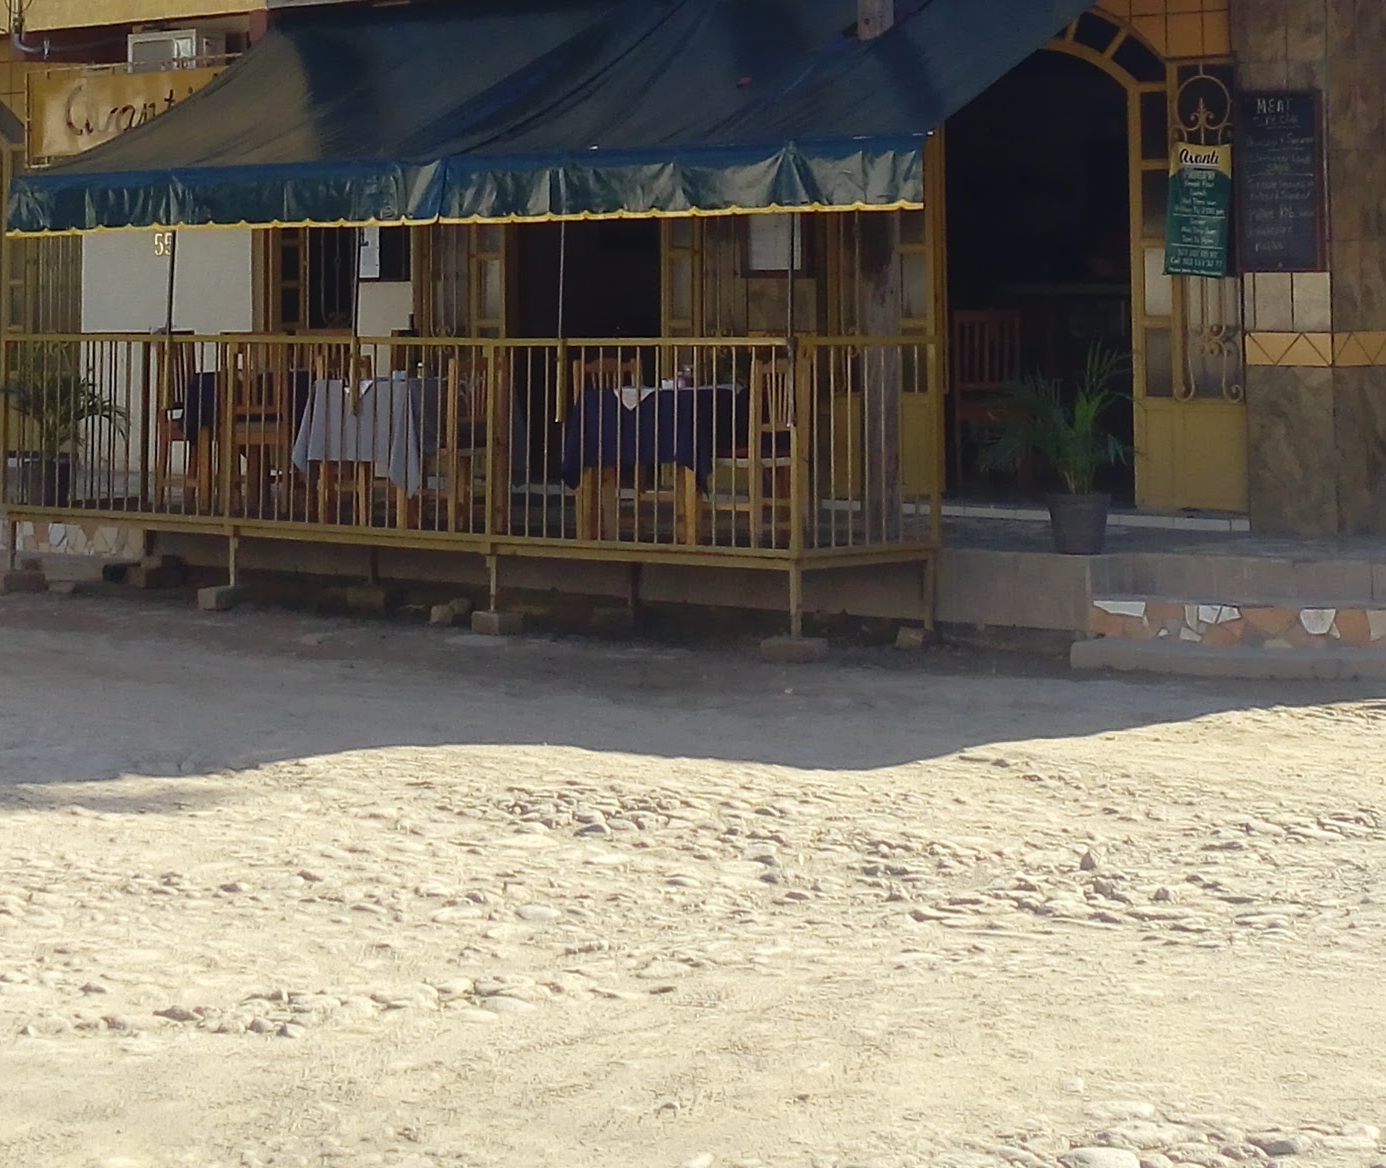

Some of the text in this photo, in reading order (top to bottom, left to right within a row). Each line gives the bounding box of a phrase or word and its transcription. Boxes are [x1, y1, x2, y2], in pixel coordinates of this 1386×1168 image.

[65, 82, 194, 136] Avant
[1256, 97, 1293, 114] MEAT
[1179, 148, 1219, 165] Avanti
